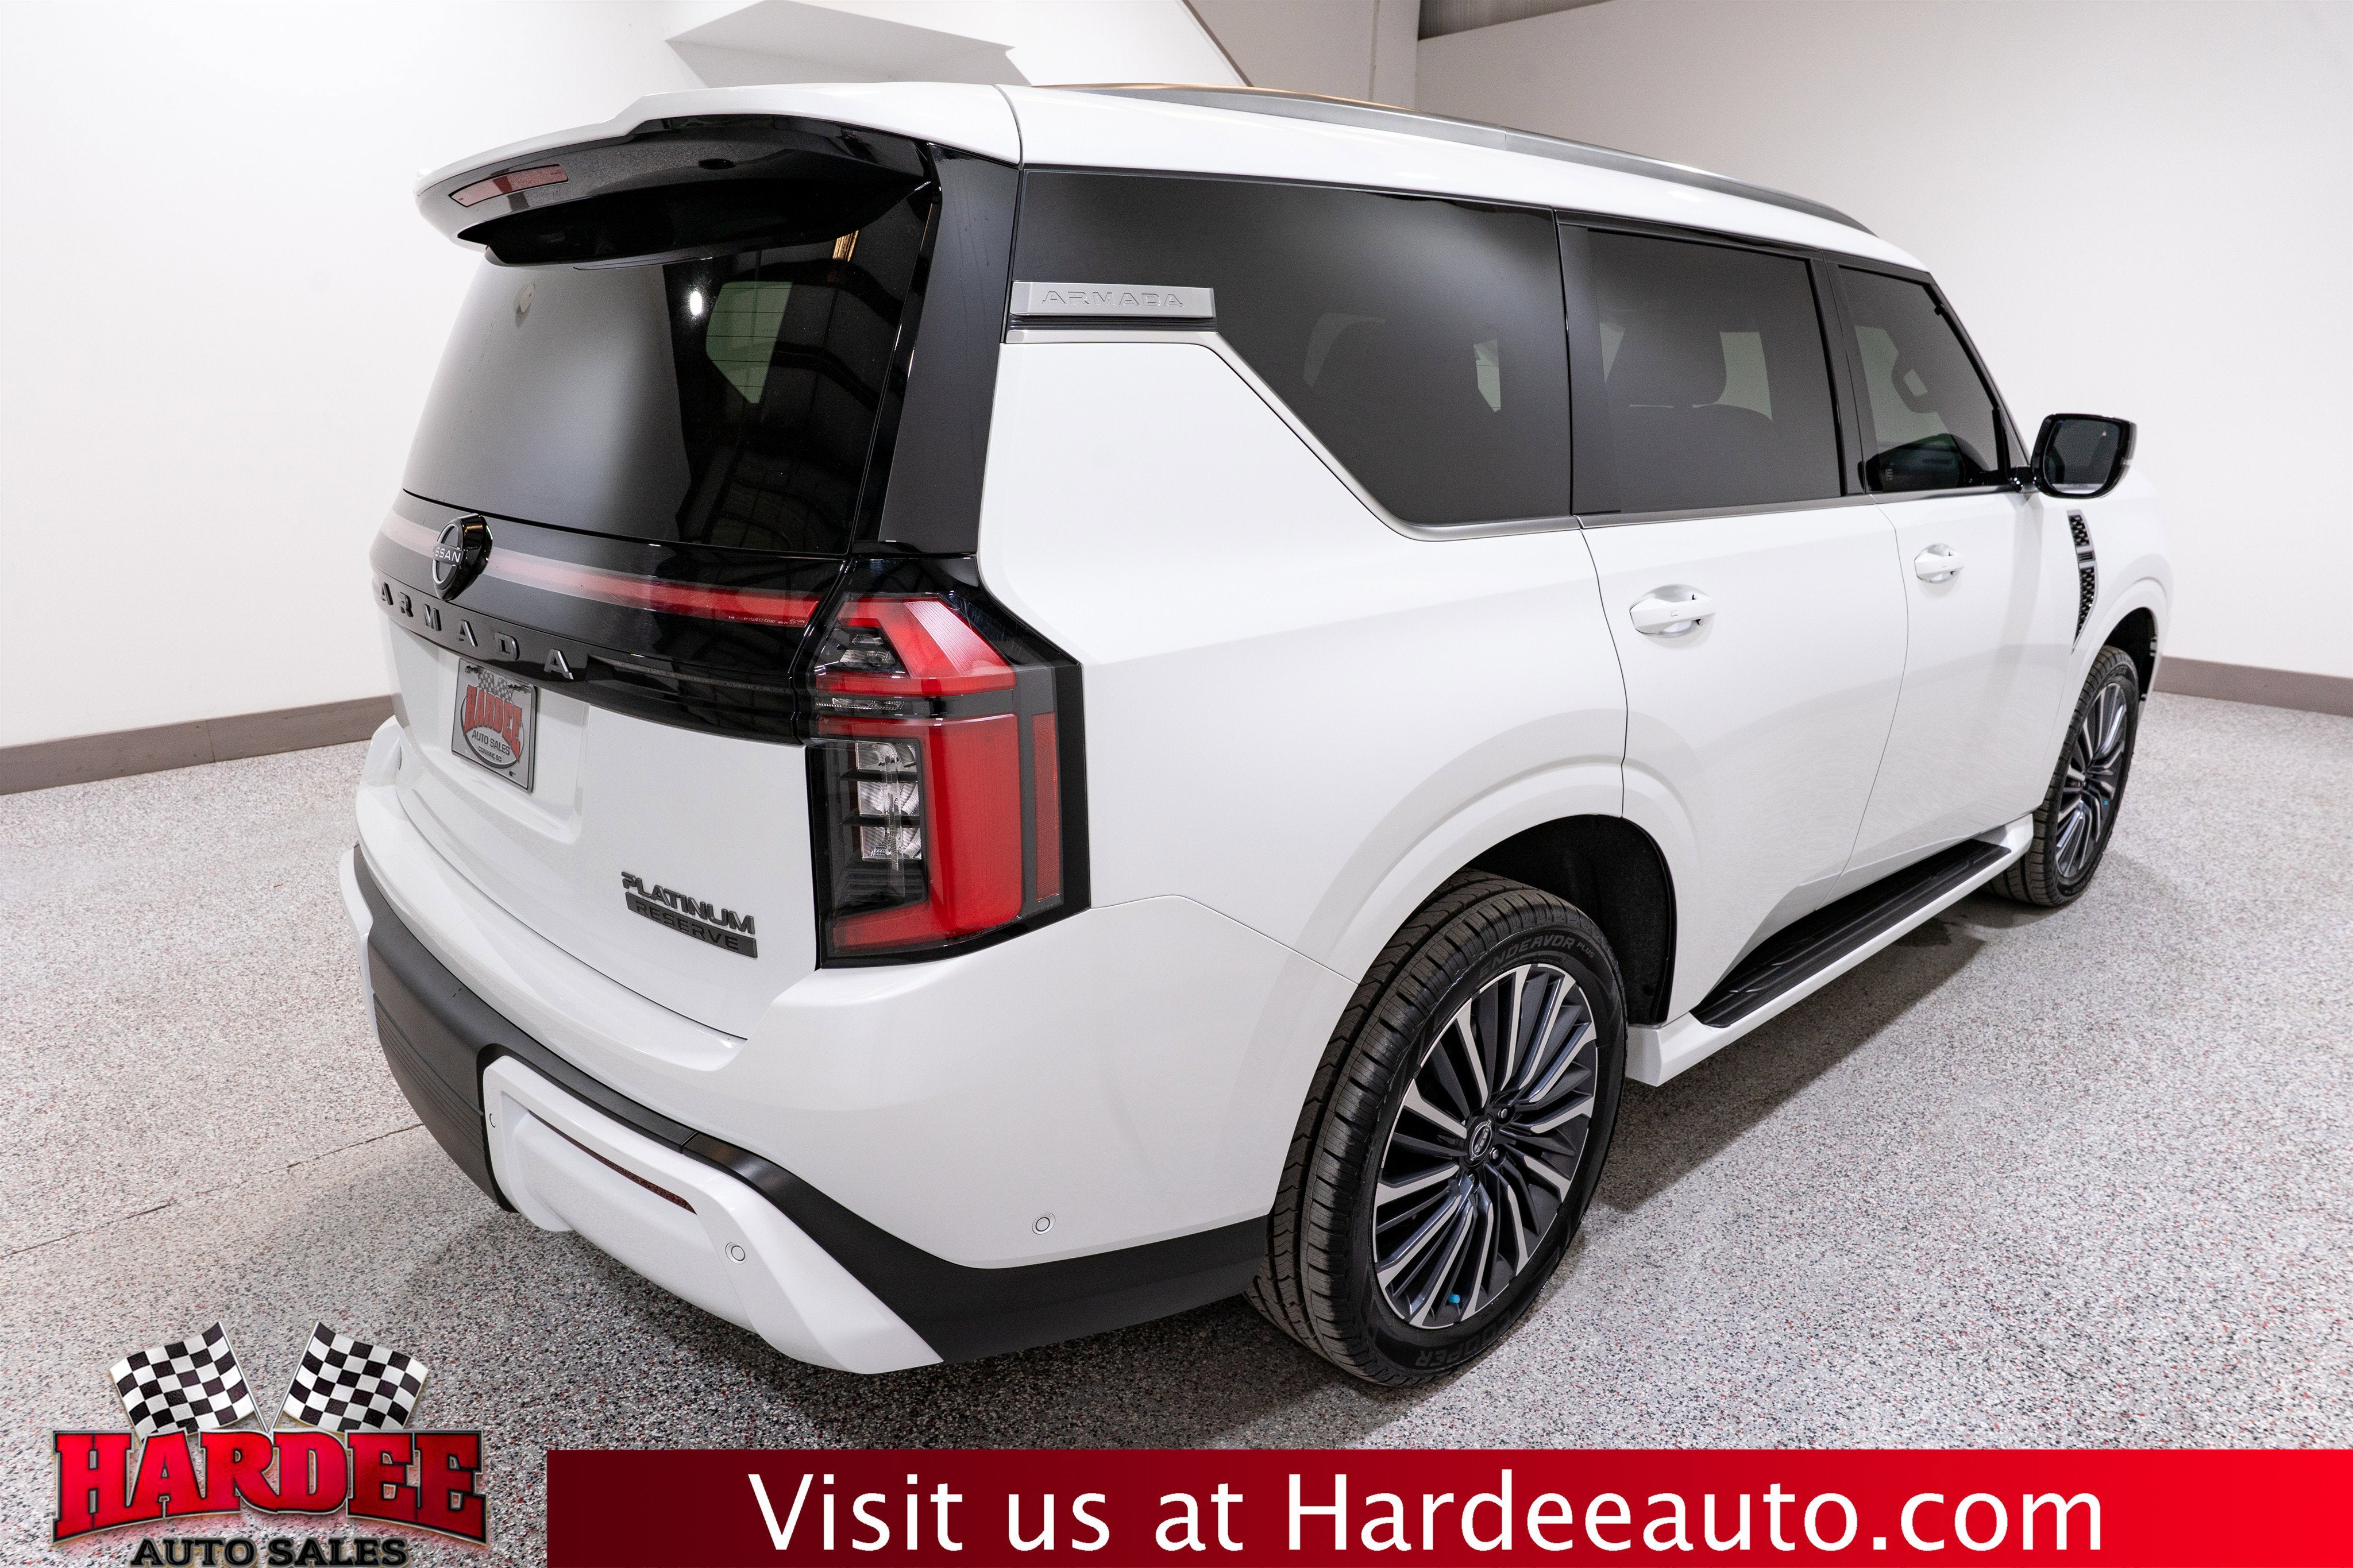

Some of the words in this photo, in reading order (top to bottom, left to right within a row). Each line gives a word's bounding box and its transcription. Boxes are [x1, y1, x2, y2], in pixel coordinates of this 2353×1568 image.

[1042, 291, 1185, 307] ARMADA
[381, 582, 574, 680] ARMADA
[463, 685, 522, 762] HARDEE
[472, 730, 488, 745] AUTO
[490, 739, 510, 755] SALES
[621, 871, 755, 934] PLATINUM
[636, 901, 739, 951] RESERVE
[1479, 935, 1575, 979] ENDEAVOR
[1576, 943, 1595, 958] PLUS
